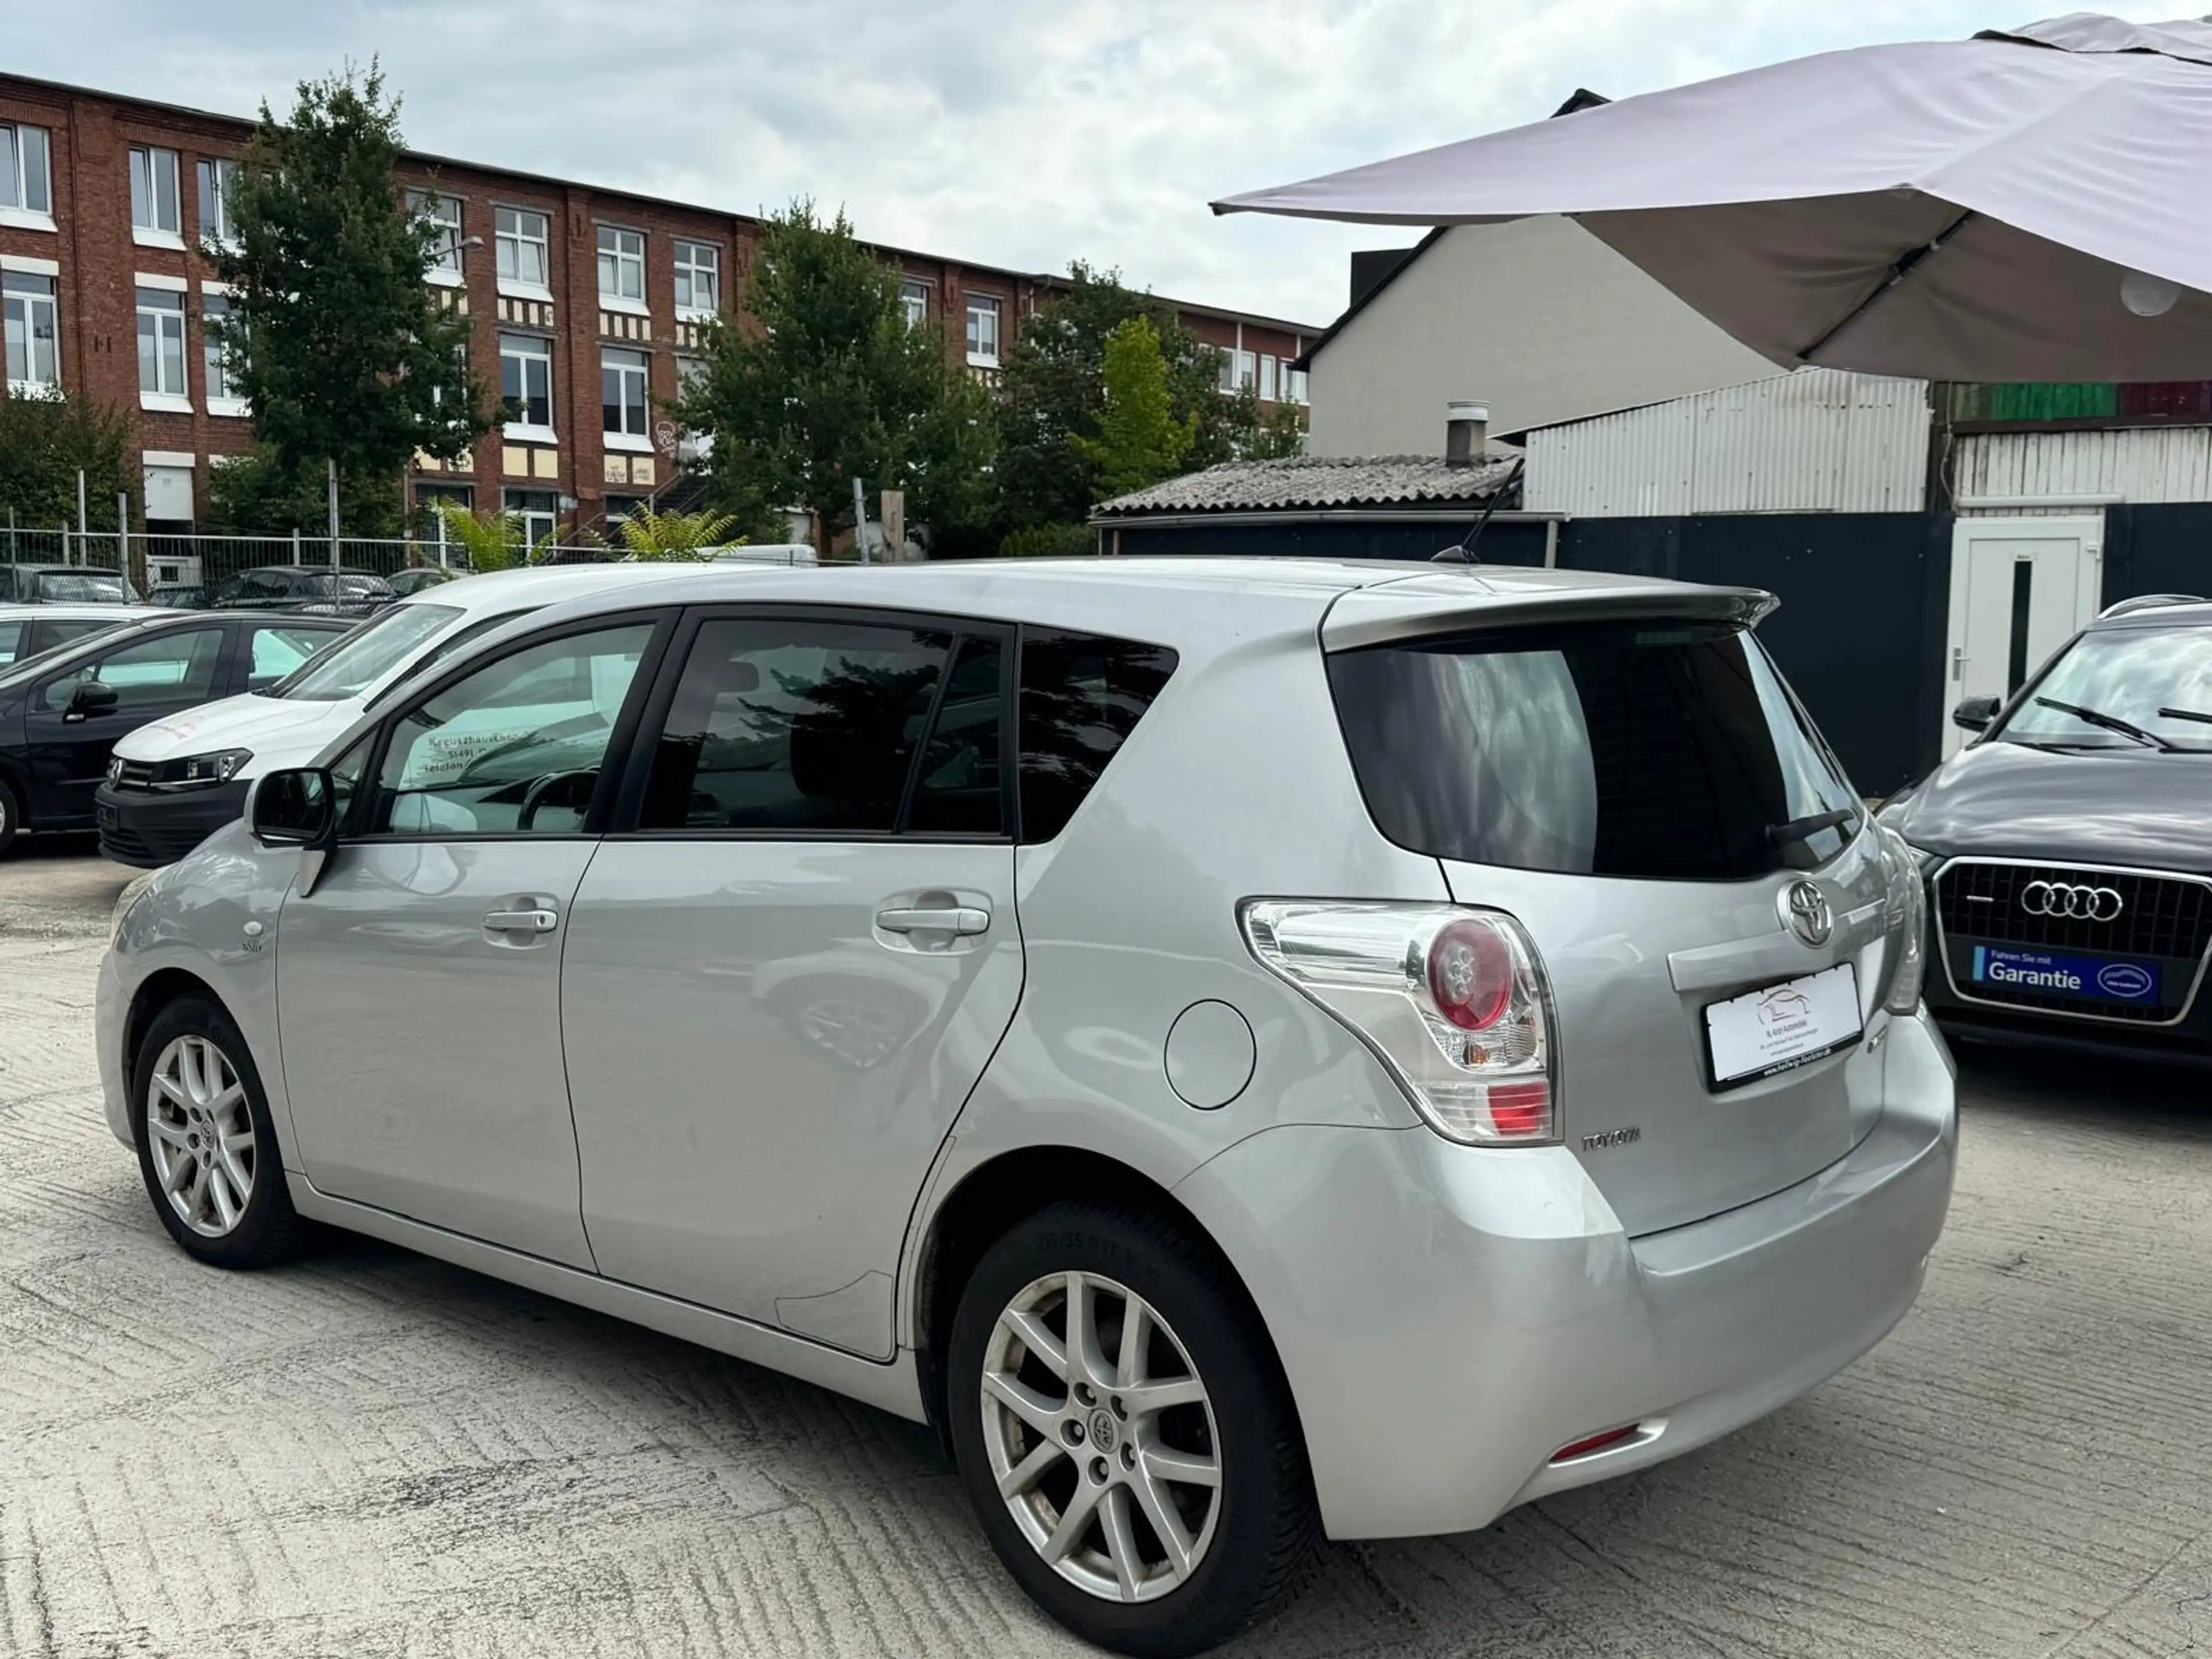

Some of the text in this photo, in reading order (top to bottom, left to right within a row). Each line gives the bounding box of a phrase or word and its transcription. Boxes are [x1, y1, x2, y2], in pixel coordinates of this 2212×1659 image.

[423, 762, 463, 772] Telefon
[1991, 949, 2051, 965] Fahren Sie mit
[1989, 961, 2081, 990] Garantie
[1582, 1126, 1641, 1152] TOYOTA
